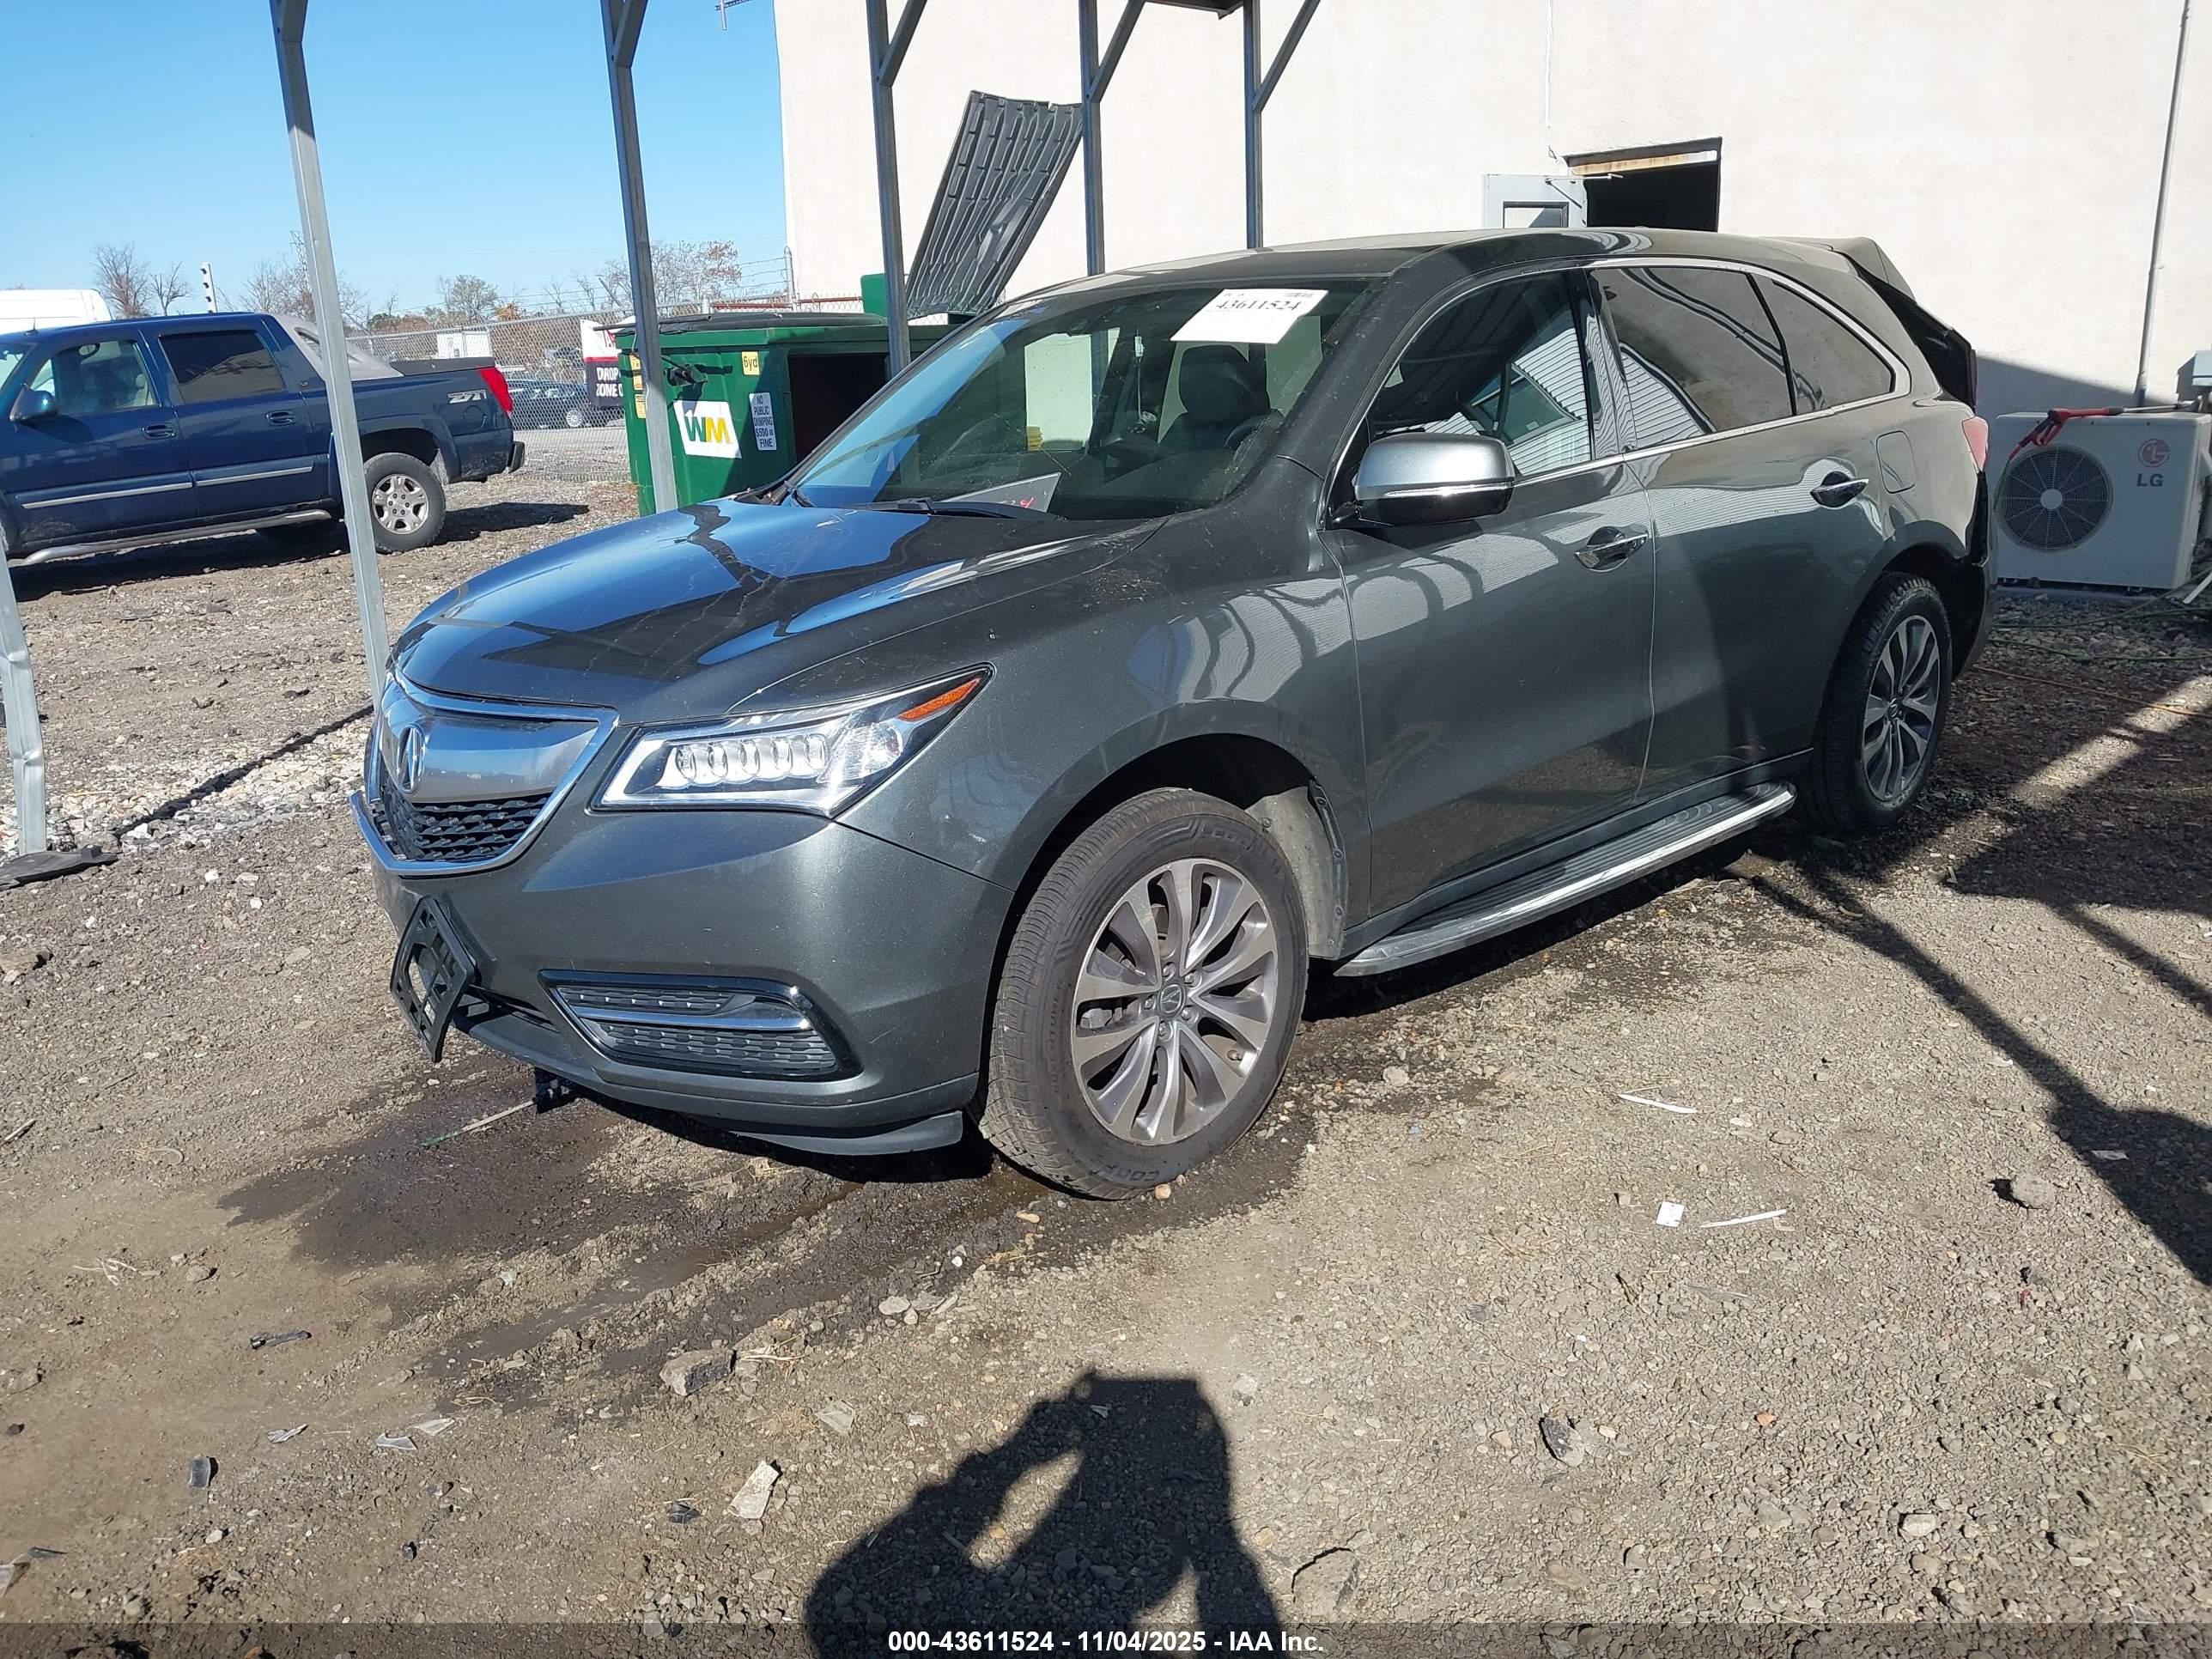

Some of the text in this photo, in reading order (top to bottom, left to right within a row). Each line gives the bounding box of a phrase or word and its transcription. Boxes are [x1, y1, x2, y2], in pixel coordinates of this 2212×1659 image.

[1216, 300, 1302, 311] 43611524
[743, 356, 758, 371] 6yd
[596, 367, 618, 380] DROP
[757, 394, 763, 404] NO
[754, 405, 769, 416] PUBLIC
[684, 416, 730, 444] WM
[759, 438, 774, 447] FINE
[2136, 473, 2164, 487] LG
